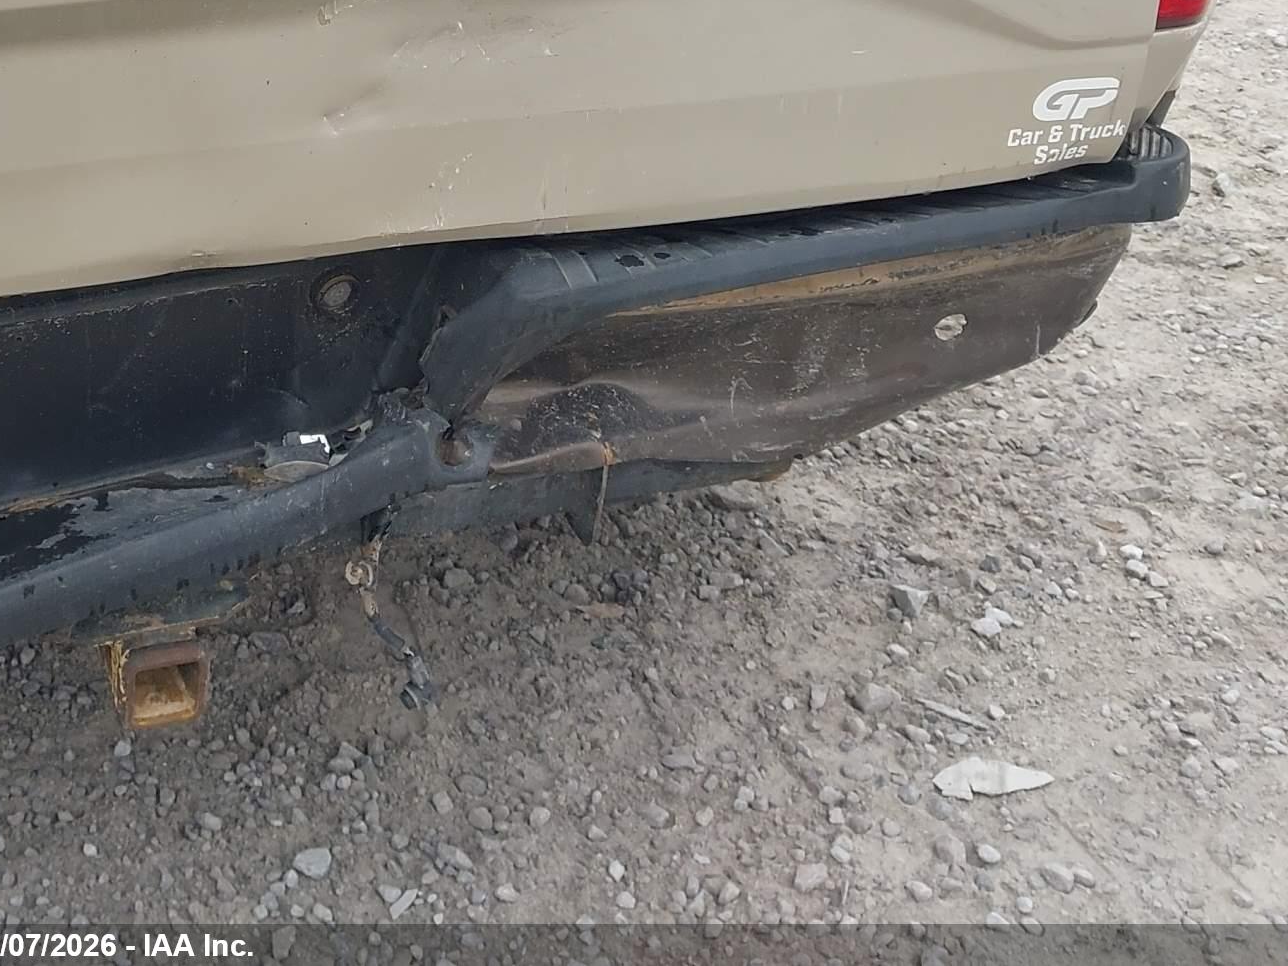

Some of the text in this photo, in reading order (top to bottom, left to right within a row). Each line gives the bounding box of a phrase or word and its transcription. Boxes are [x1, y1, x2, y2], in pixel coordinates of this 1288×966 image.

[1033, 78, 1120, 121] GP
[1008, 120, 1125, 146] Car & Truck
